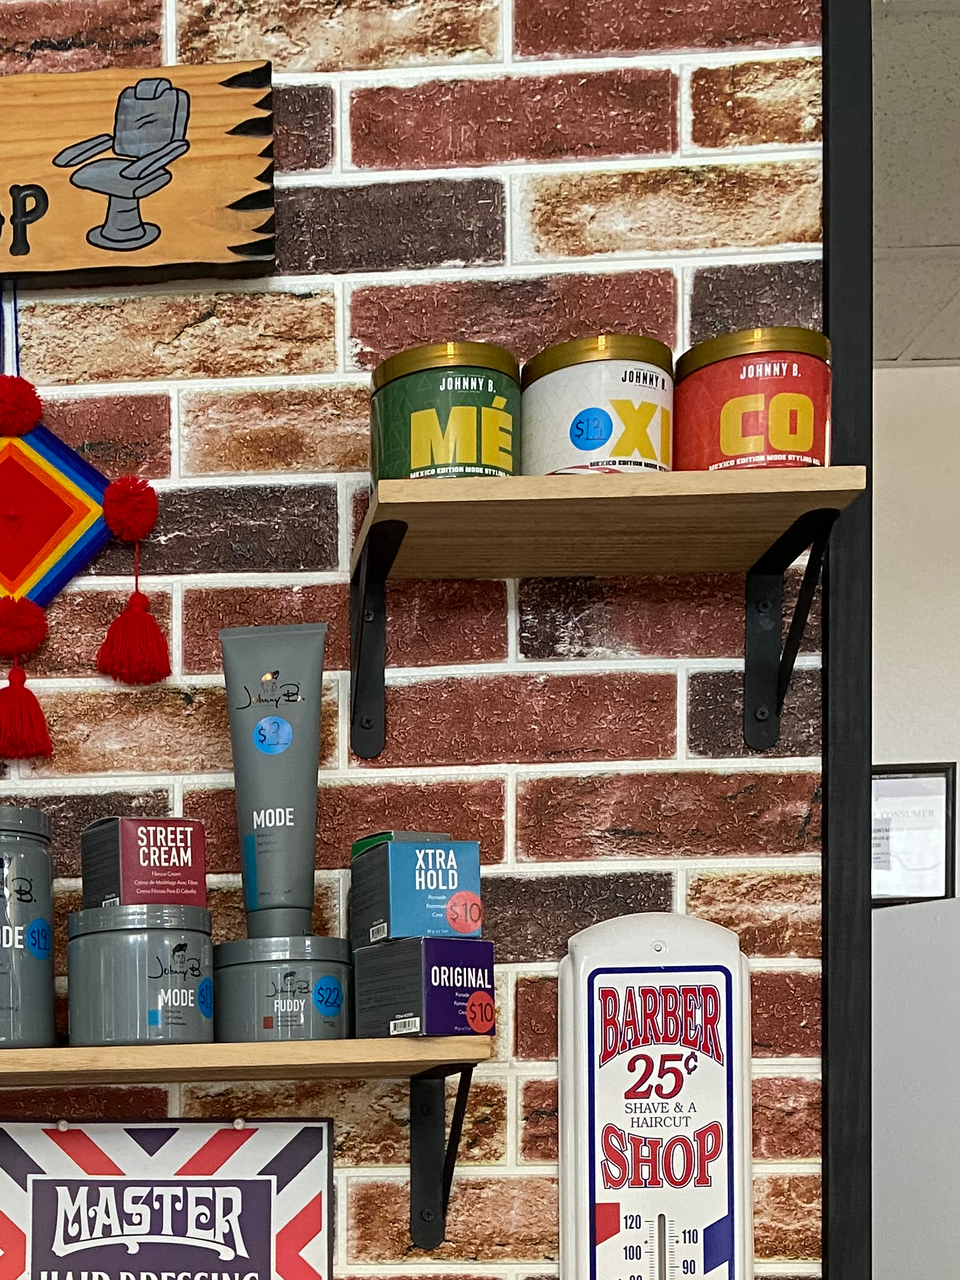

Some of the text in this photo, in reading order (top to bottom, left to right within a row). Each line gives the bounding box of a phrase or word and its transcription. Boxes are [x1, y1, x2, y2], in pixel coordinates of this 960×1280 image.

[621, 370, 658, 388] JOHNNY
[740, 362, 801, 379] JOHNNY B.
[440, 377, 496, 393] JOHNNY B.
[411, 395, 513, 472] MÉ
[720, 393, 814, 456] CO
[253, 808, 294, 829] MODE
[138, 827, 193, 846] STREET
[139, 847, 192, 866] CREAM
[415, 850, 457, 869] XTRA
[415, 870, 458, 890] HOLD
[450, 902, 482, 922] $10
[431, 966, 491, 988] ORIGINAL
[161, 989, 194, 1007] MODE
[318, 986, 340, 1007] $22
[470, 1002, 494, 1022] $10
[599, 985, 724, 1069] BARBER
[624, 1052, 698, 1100] 25¢
[625, 1102, 697, 1113] SHAVE & A
[631, 1116, 691, 1128] HAIRCUT
[601, 1121, 723, 1190] SHOP
[51, 1186, 250, 1261] MASTER
[624, 1215, 641, 1229] 120
[682, 1229, 698, 1243] 110
[624, 1246, 641, 1260] 100
[682, 1260, 695, 1274] 90
